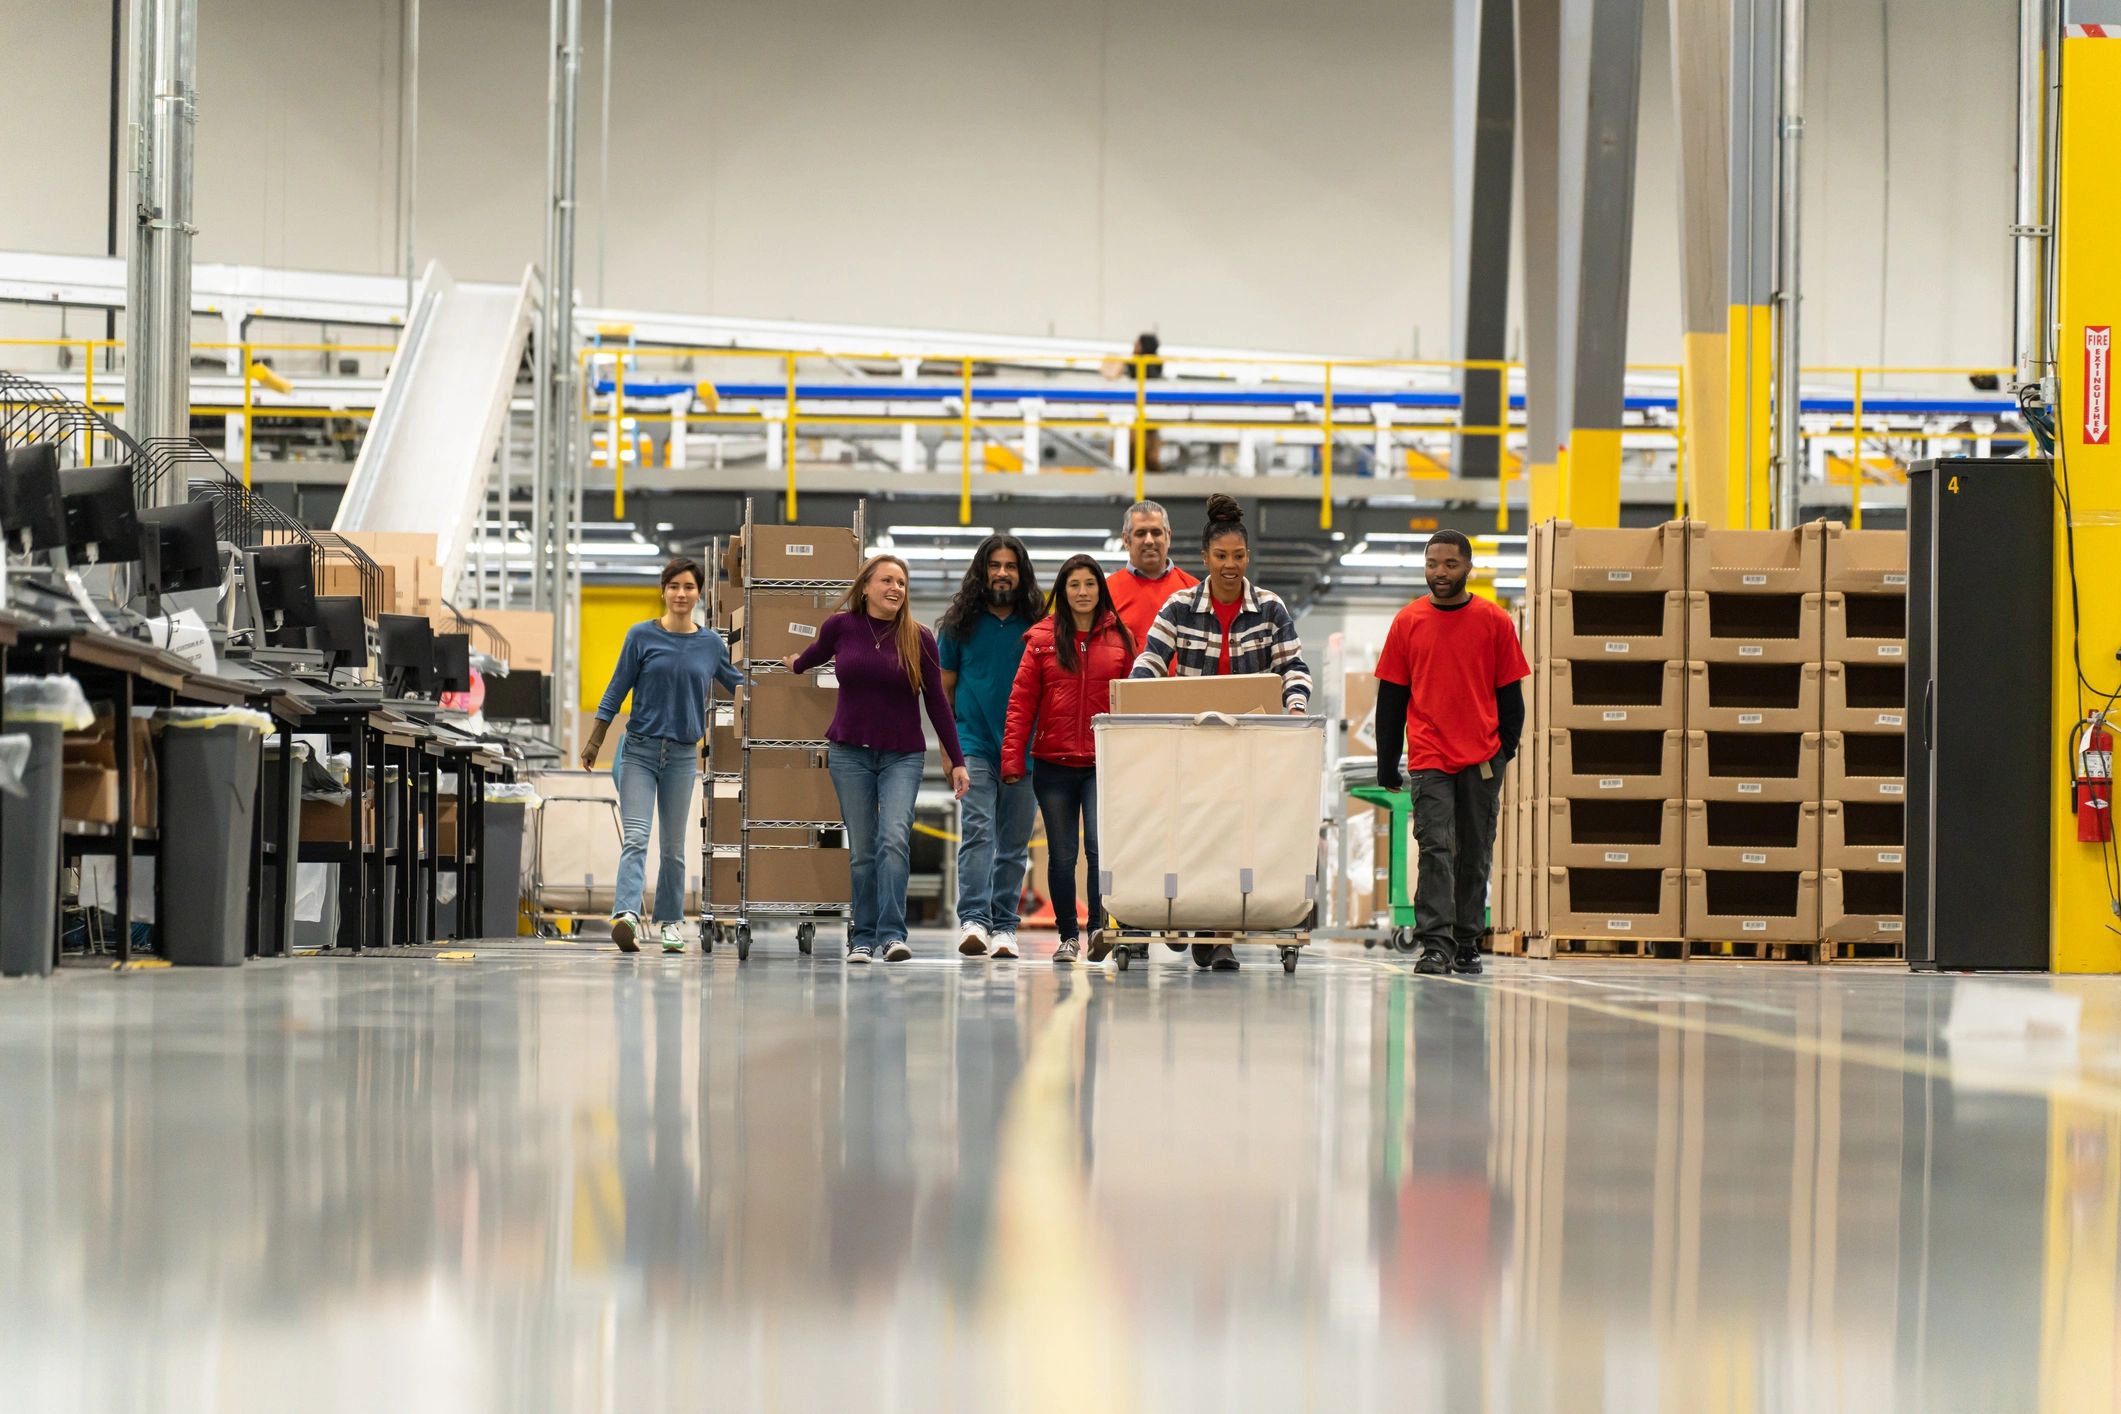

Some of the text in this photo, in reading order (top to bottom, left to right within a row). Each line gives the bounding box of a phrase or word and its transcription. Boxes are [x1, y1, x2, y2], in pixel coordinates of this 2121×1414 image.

[2088, 335, 2108, 346] FIRE
[2093, 349, 2102, 434] EXTINGUISHER
[1948, 476, 1960, 494] 4
